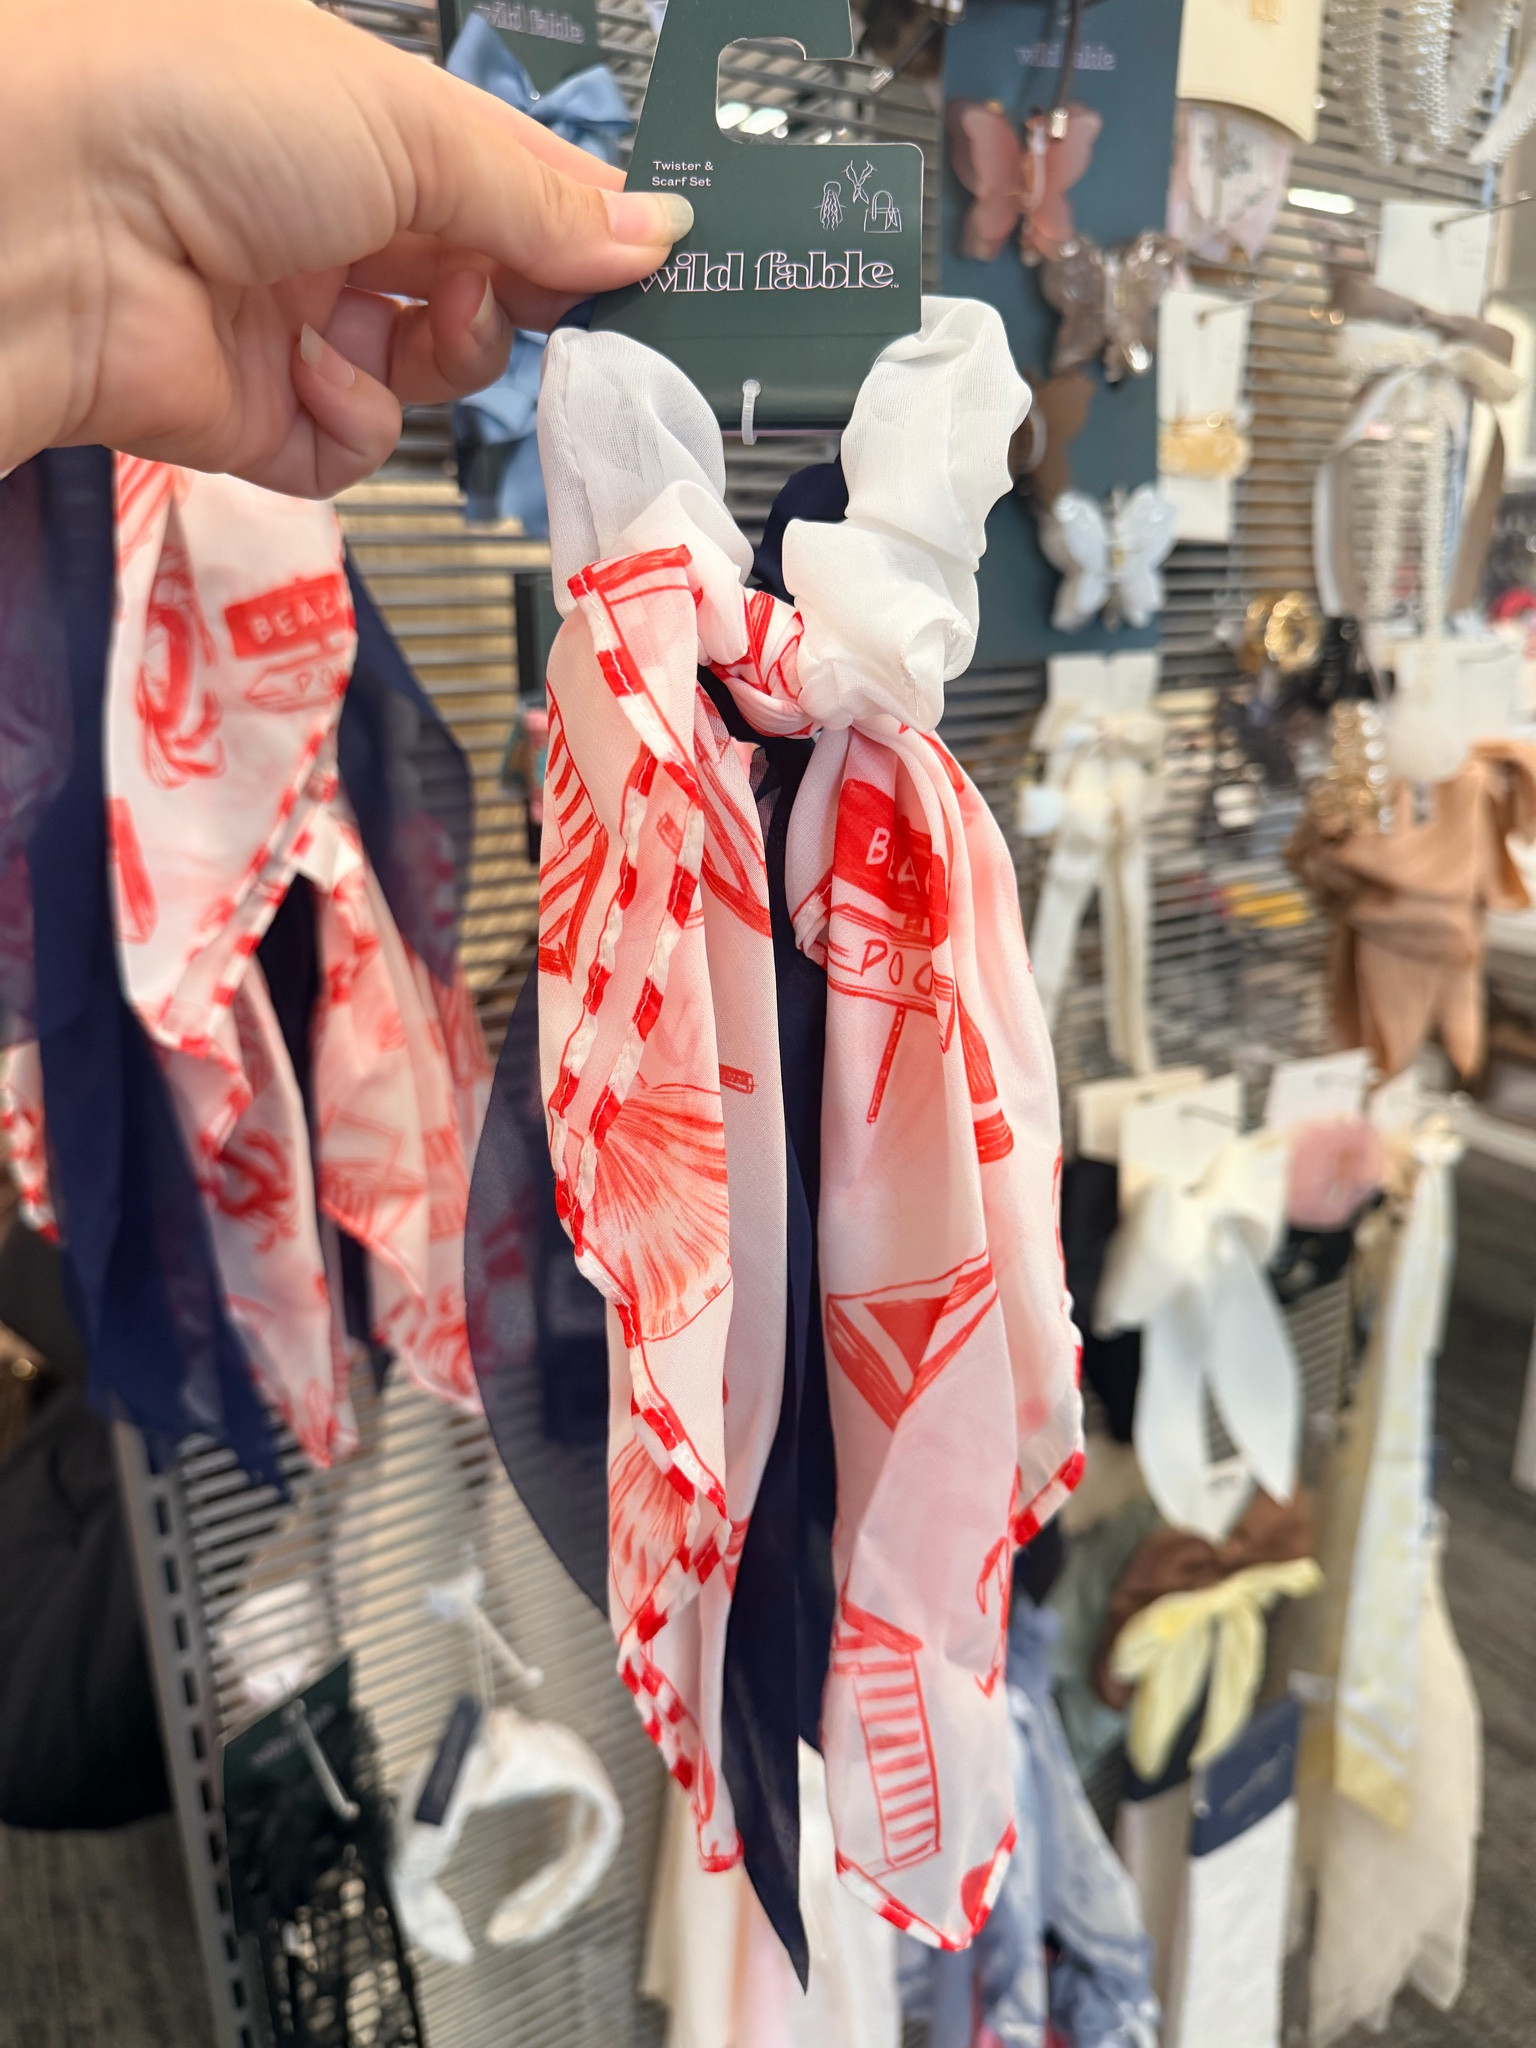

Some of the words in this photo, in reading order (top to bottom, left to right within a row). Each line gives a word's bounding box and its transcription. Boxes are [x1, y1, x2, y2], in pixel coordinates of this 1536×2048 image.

[652, 160, 701, 171] Twister
[704, 161, 714, 171] &
[651, 176, 687, 186] Scarf
[689, 176, 712, 186] Set
